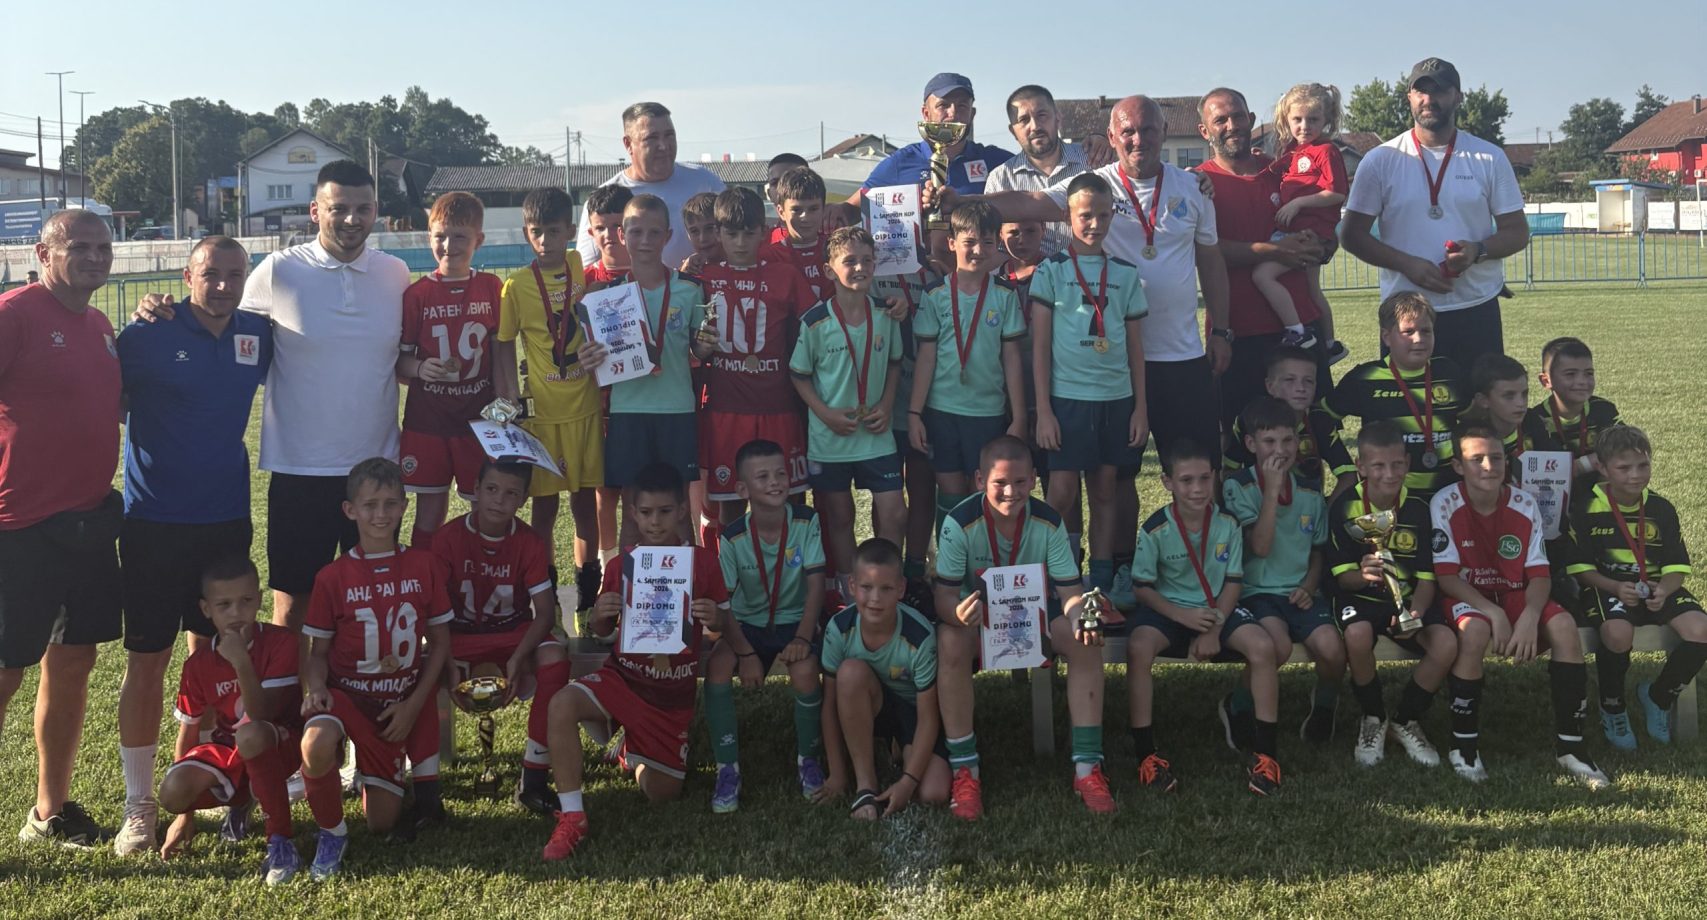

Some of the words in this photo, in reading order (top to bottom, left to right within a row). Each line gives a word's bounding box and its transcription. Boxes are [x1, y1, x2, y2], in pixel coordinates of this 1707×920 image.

[711, 293, 767, 354] 10
[1082, 295, 1108, 336] 7
[432, 321, 487, 381] 19
[1590, 527, 1615, 535] Zeus
[460, 580, 516, 617] 14
[636, 602, 675, 610] DIPLOMU
[1608, 597, 1627, 612] 2
[993, 621, 1032, 630] DIPLOMU
[1342, 606, 1357, 620] 8
[354, 602, 418, 673] 18
